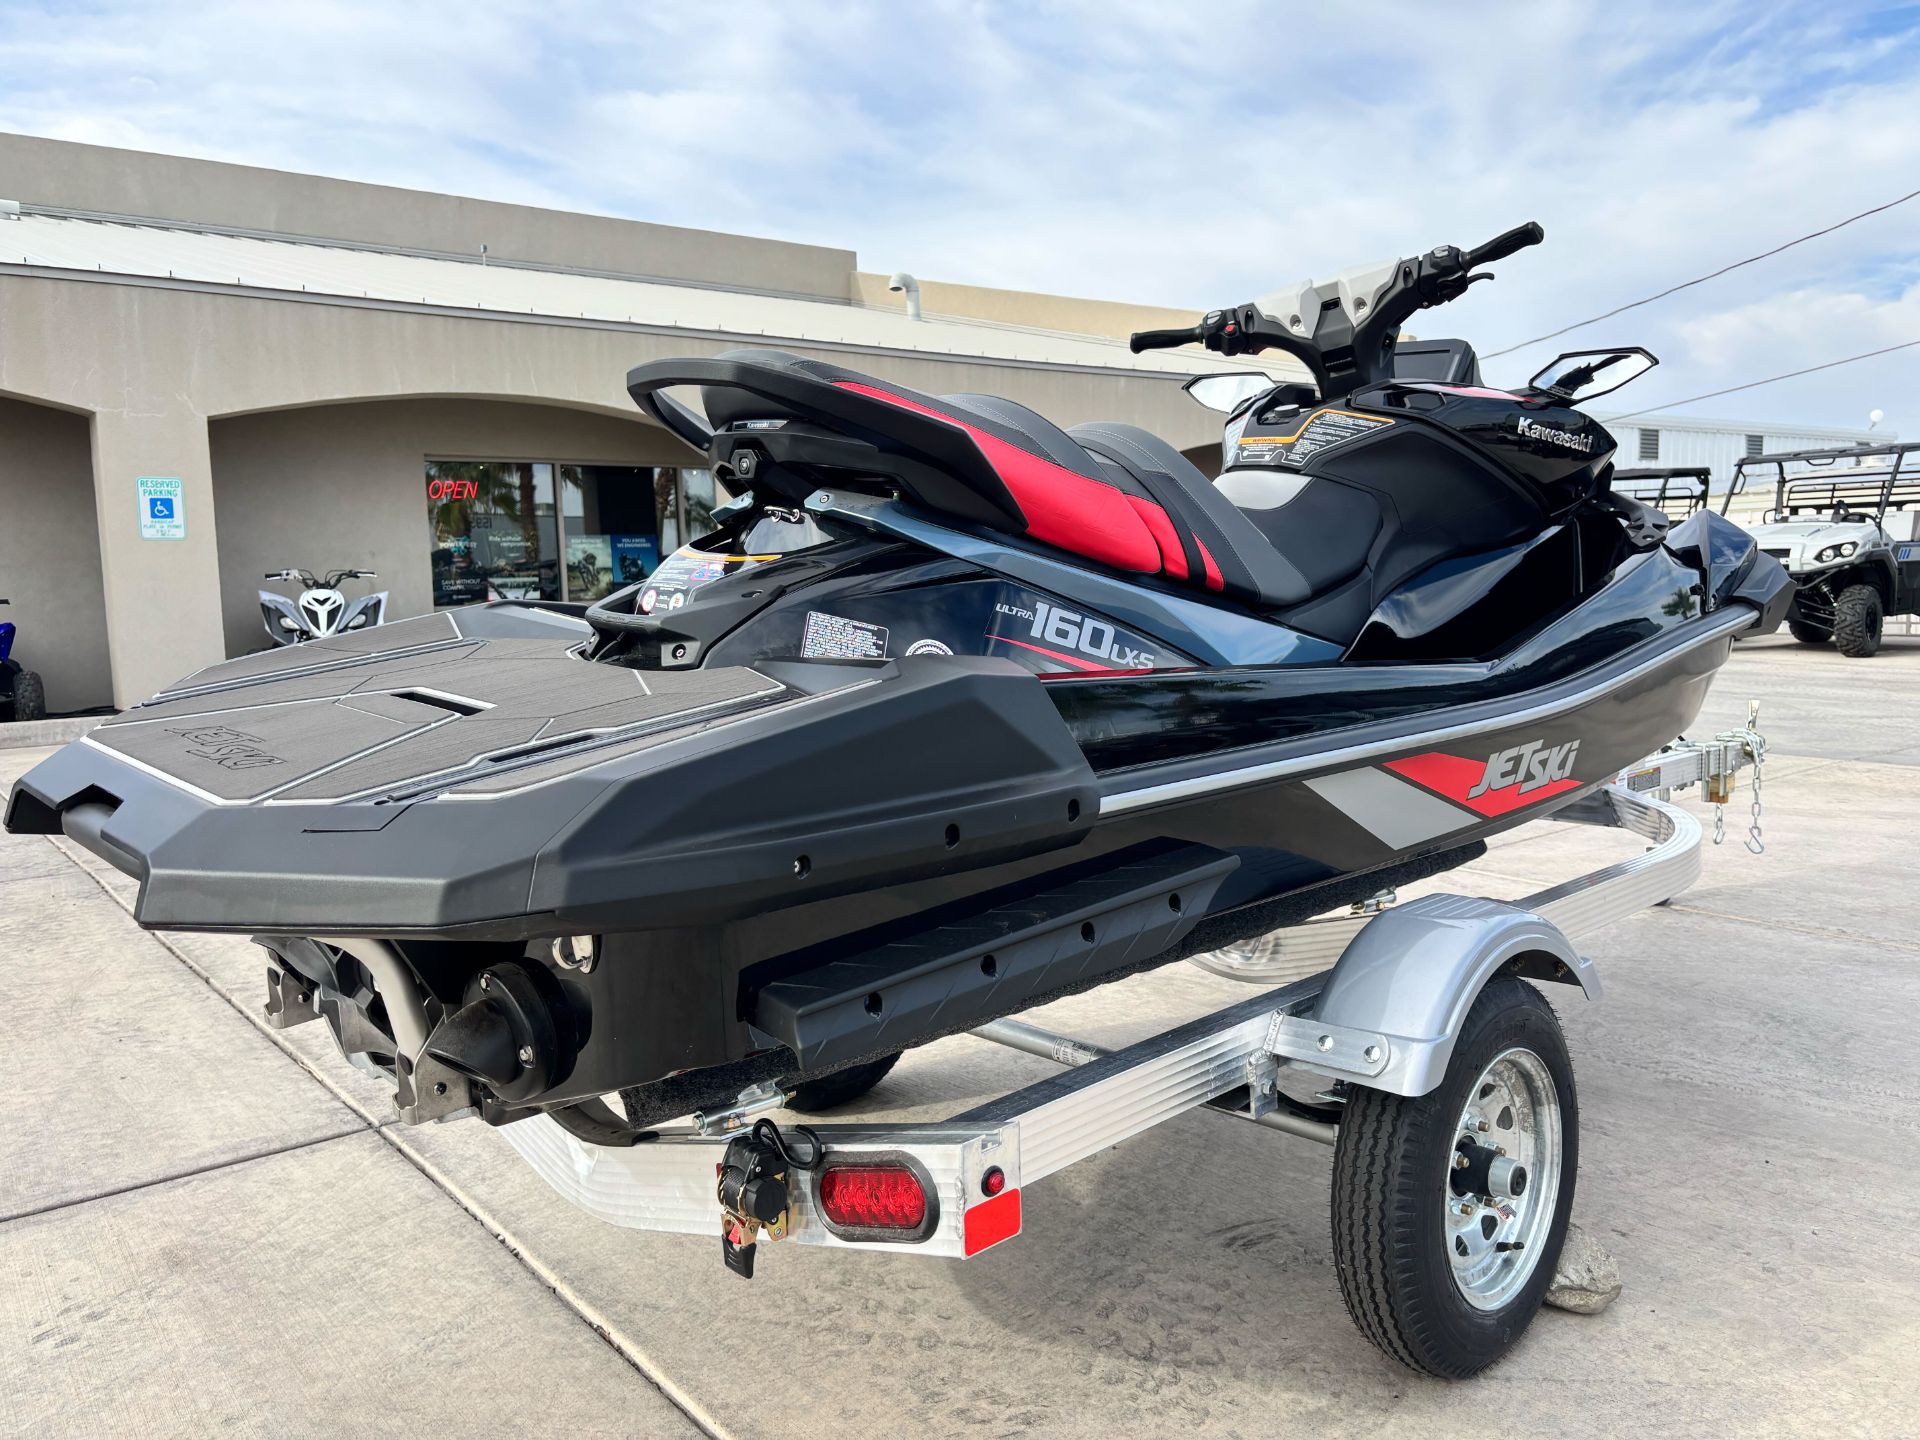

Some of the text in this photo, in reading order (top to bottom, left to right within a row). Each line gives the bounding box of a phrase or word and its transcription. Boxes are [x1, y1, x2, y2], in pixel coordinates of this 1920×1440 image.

[1517, 416, 1593, 452] Kawasaki
[140, 480, 180, 489] RESERVED
[143, 489, 178, 497] PARKING
[428, 479, 478, 499] OPEN
[995, 603, 1034, 621] ULTRA
[1030, 601, 1115, 659] 160
